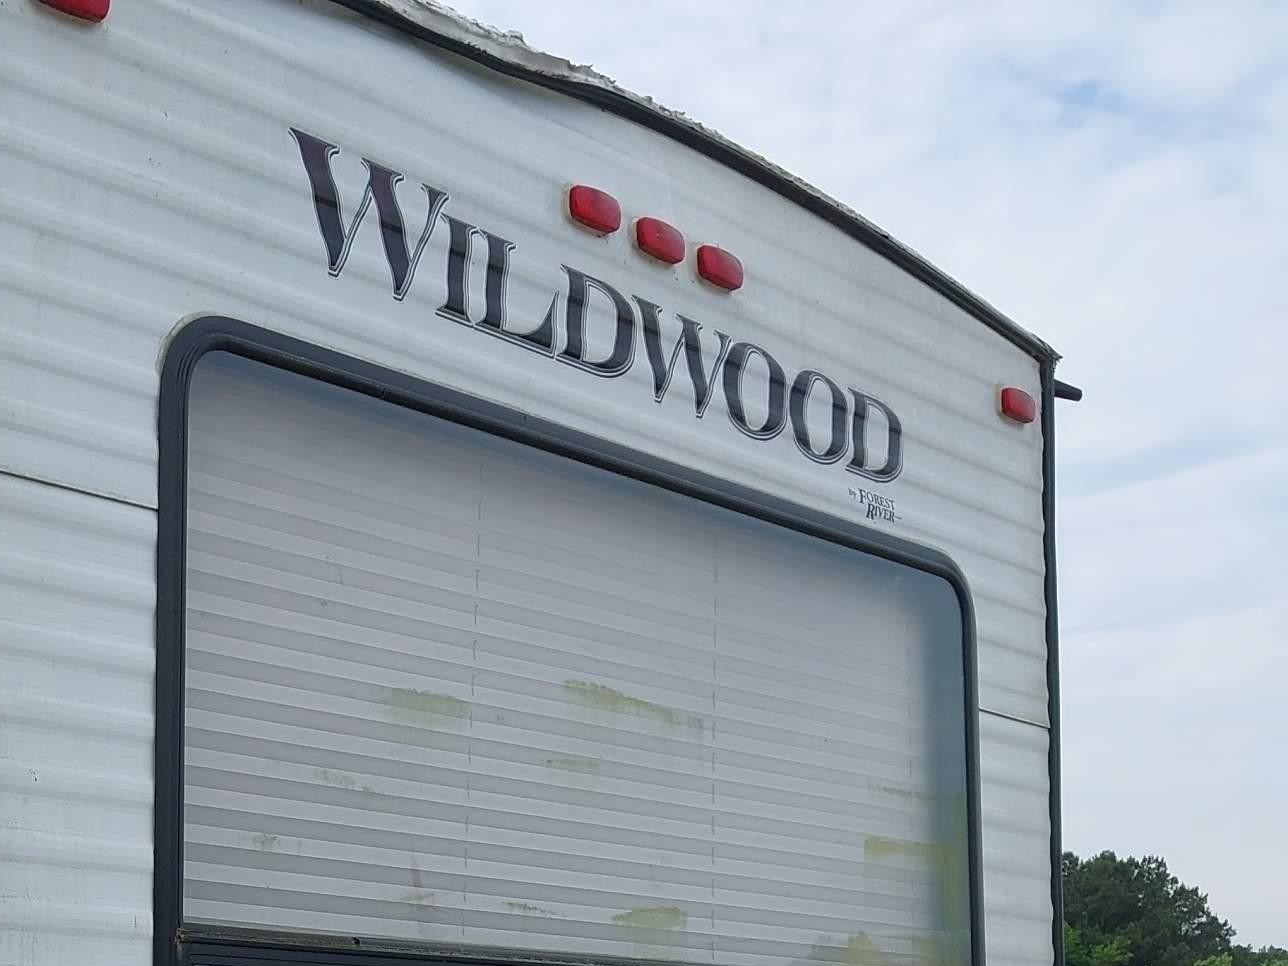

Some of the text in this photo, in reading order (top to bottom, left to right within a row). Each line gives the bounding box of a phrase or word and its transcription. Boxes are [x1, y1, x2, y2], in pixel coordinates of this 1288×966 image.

[289, 127, 903, 483] WILDWOOD
[858, 488, 895, 510] FOREST
[866, 503, 895, 523] RIVER
